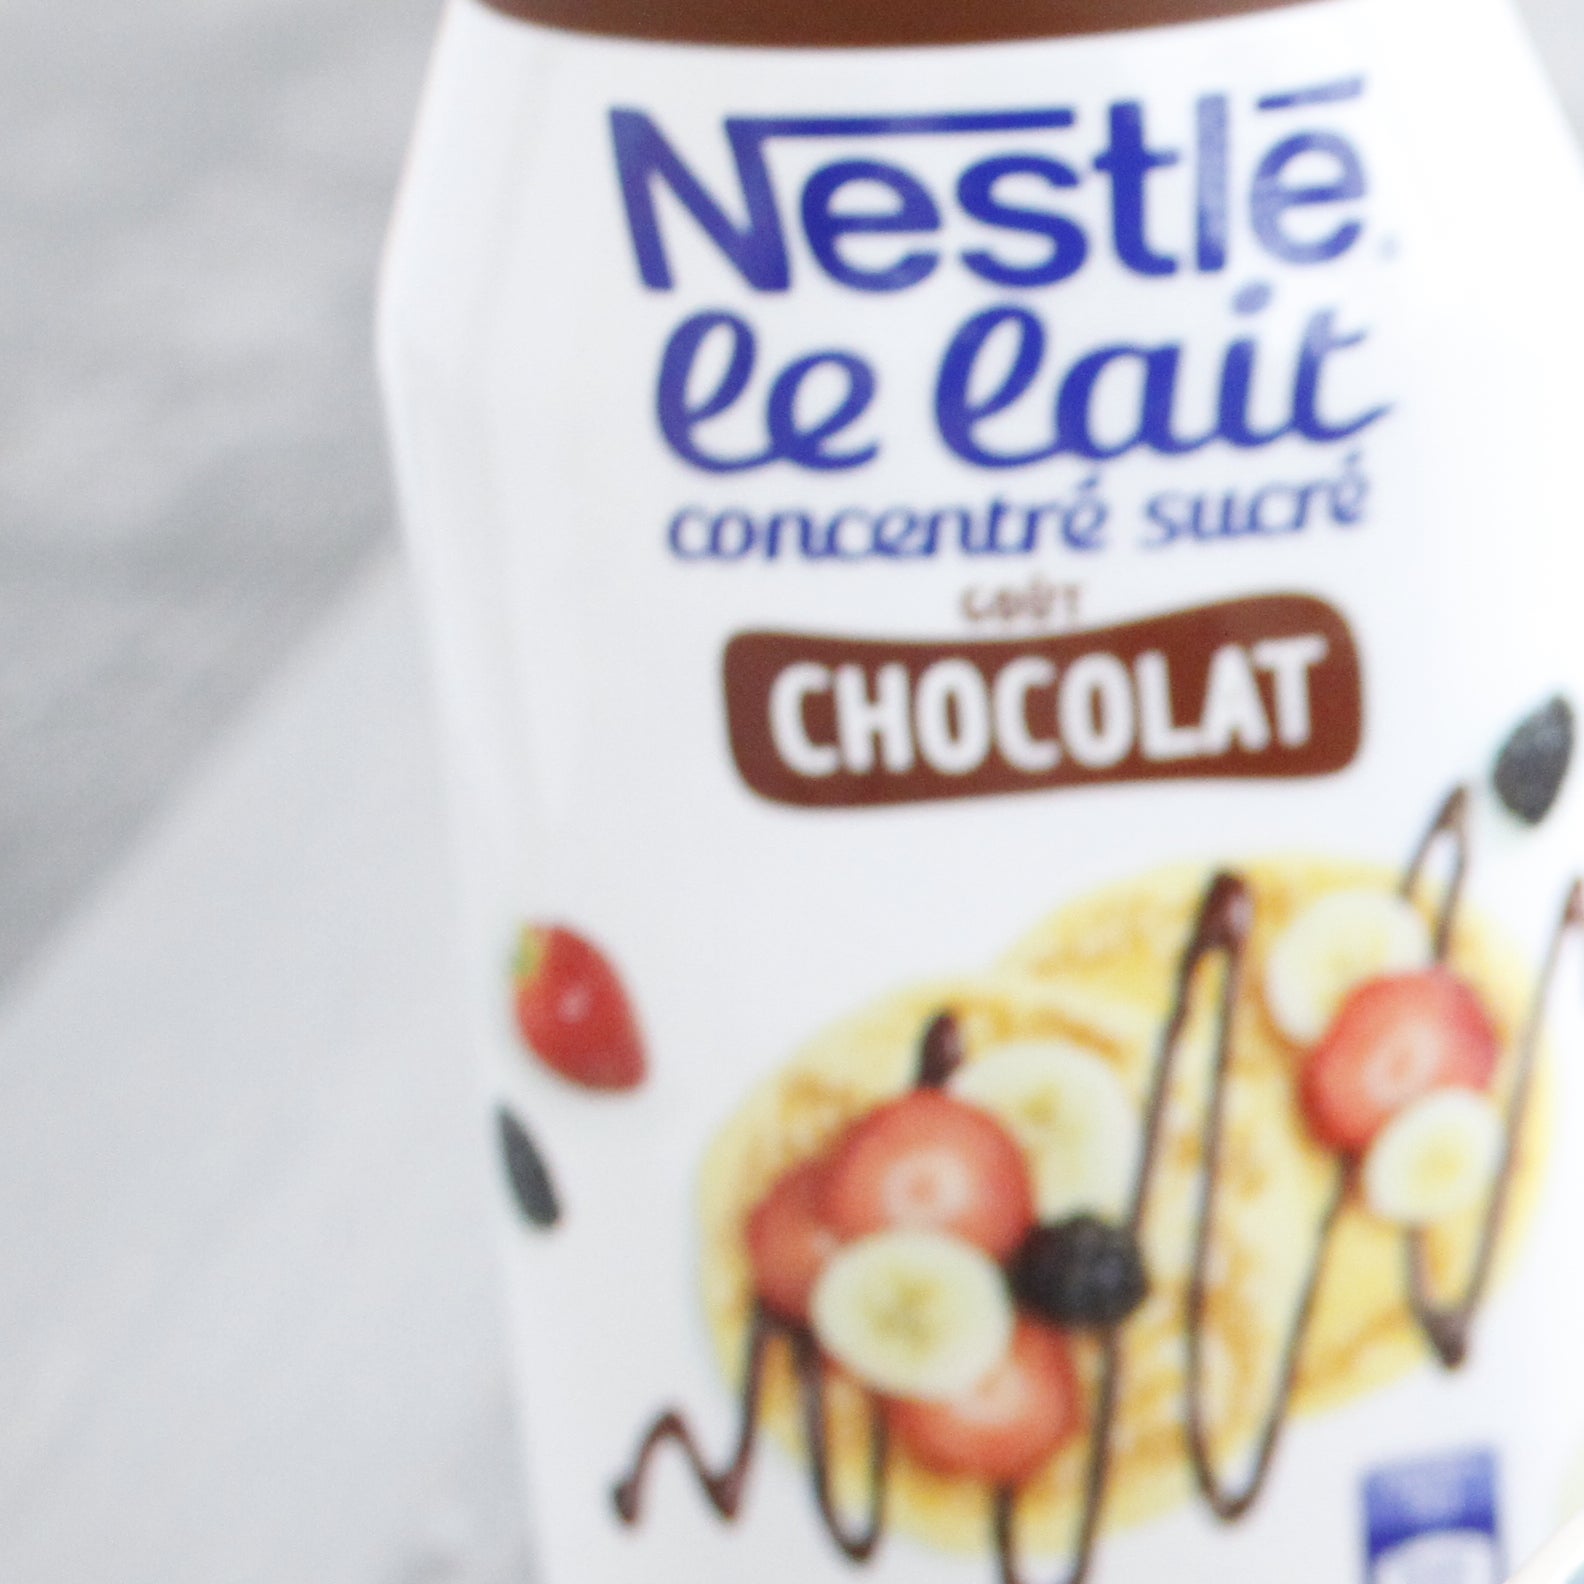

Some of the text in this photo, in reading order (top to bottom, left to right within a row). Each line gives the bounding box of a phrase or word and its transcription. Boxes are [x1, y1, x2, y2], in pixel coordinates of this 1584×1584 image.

[609, 77, 1367, 291] Nestlé
[657, 283, 1395, 473] le lait
[669, 453, 1369, 562] concentré sucré
[770, 635, 1327, 777] CHOCOLAT
